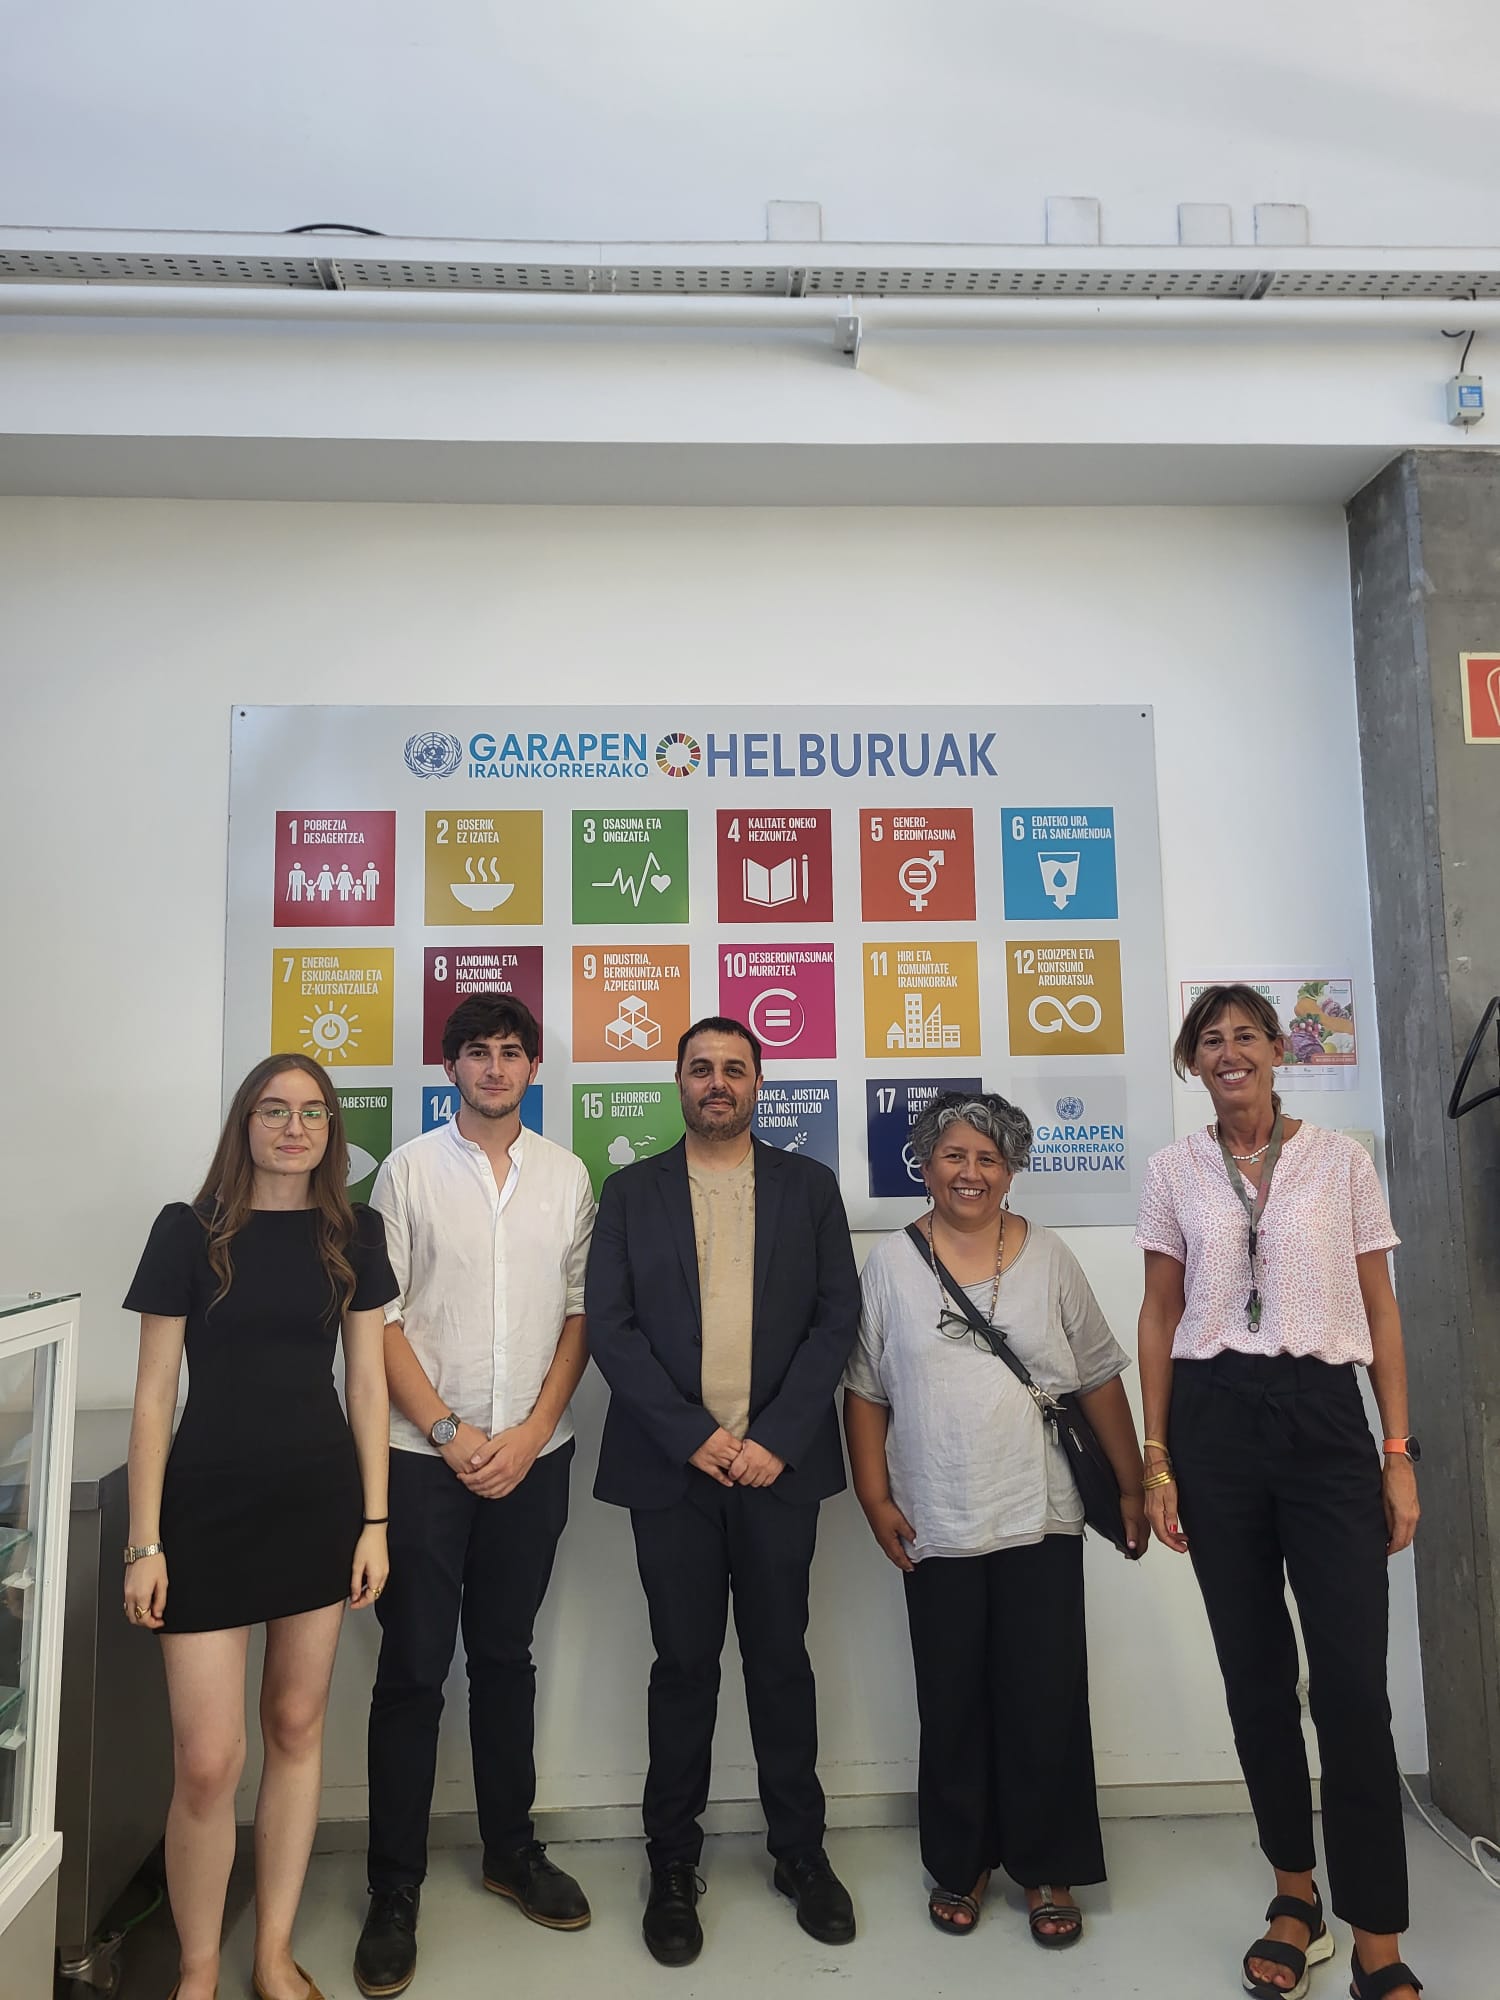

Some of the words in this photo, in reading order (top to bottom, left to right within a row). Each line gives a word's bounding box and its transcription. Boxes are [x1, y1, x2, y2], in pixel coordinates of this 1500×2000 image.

[468, 733, 647, 761] GARAPEN
[706, 732, 999, 777] HELBURUAK
[468, 762, 649, 778] IRAUNKORRERAKO
[304, 819, 347, 831] POBREZIA
[457, 819, 494, 830] GOSERIK
[603, 818, 643, 830] OSASUNA
[646, 818, 661, 829] ETA
[748, 817, 786, 828] KALITATE
[789, 817, 817, 828] ONEKO
[893, 816, 929, 828] GENERO-
[1031, 815, 1068, 827] EDATEKO
[1070, 815, 1088, 827] URA
[289, 820, 298, 844] 1
[436, 819, 449, 844] 2
[583, 818, 596, 843] 3
[727, 817, 740, 842] 4
[871, 817, 883, 842] 5
[1012, 815, 1025, 841] 6
[1032, 828, 1047, 840] ETA
[1050, 828, 1112, 840] SANEAMENDUA
[304, 832, 365, 844] DESAGERTZEA
[457, 832, 467, 843] EZ
[470, 832, 499, 843] IZATEA
[603, 831, 650, 842] ONGIZATEA
[748, 830, 797, 842] HEZKUNTZA
[893, 829, 956, 840] BERDINTASUNA
[603, 953, 651, 965] INDUSTRIA,
[749, 951, 833, 964] DESBERDINTASUNAK
[897, 950, 914, 962] HIRI
[916, 950, 932, 961] ETA
[1037, 948, 1077, 960] EKOIZPEN
[1079, 948, 1094, 960] ETA
[302, 956, 339, 968] ENERGIA
[456, 955, 500, 966] LANDUINA
[502, 955, 518, 966] ETA
[583, 953, 597, 980] 9
[723, 952, 747, 978] 10
[870, 951, 888, 976] 11
[1013, 949, 1035, 974] 12
[282, 957, 295, 983] 7
[434, 955, 448, 982] 8
[603, 966, 662, 978] BERRIKUNTZA
[664, 966, 680, 978] ETA
[749, 964, 796, 977] MURRIZTEA
[897, 963, 949, 975] KOMUNITATE
[1037, 961, 1083, 973] KONTSUMO
[301, 969, 364, 982] ESKURAGARRI
[366, 969, 382, 981] ETA
[456, 968, 502, 980] HAZKUNDE
[1038, 974, 1094, 986] ARDURATSUA
[456, 981, 512, 994] EKONOMIKOA
[603, 979, 660, 991] AZPIEGITURA
[898, 976, 958, 988] IRAUNKORRAK
[301, 983, 379, 995] EZ-KUTSATZAILEA
[611, 1091, 661, 1104] LEHORREKO
[757, 1089, 789, 1102] BAKEA,
[791, 1088, 830, 1101] JUSTIZIA
[907, 1087, 939, 1099] ITUNAK
[581, 1092, 604, 1119] 15
[876, 1087, 896, 1114] 17
[430, 1095, 453, 1121] 14
[611, 1105, 644, 1117] BIZITZA
[757, 1103, 773, 1115] ETA
[776, 1102, 822, 1114] INSTITUZIO
[758, 1116, 799, 1128] SENDOAK
[1036, 1125, 1124, 1141] GARAPEN
[1029, 1142, 1125, 1154] AUNKORRERAKO
[1028, 1155, 1126, 1172] ELBURUAK
